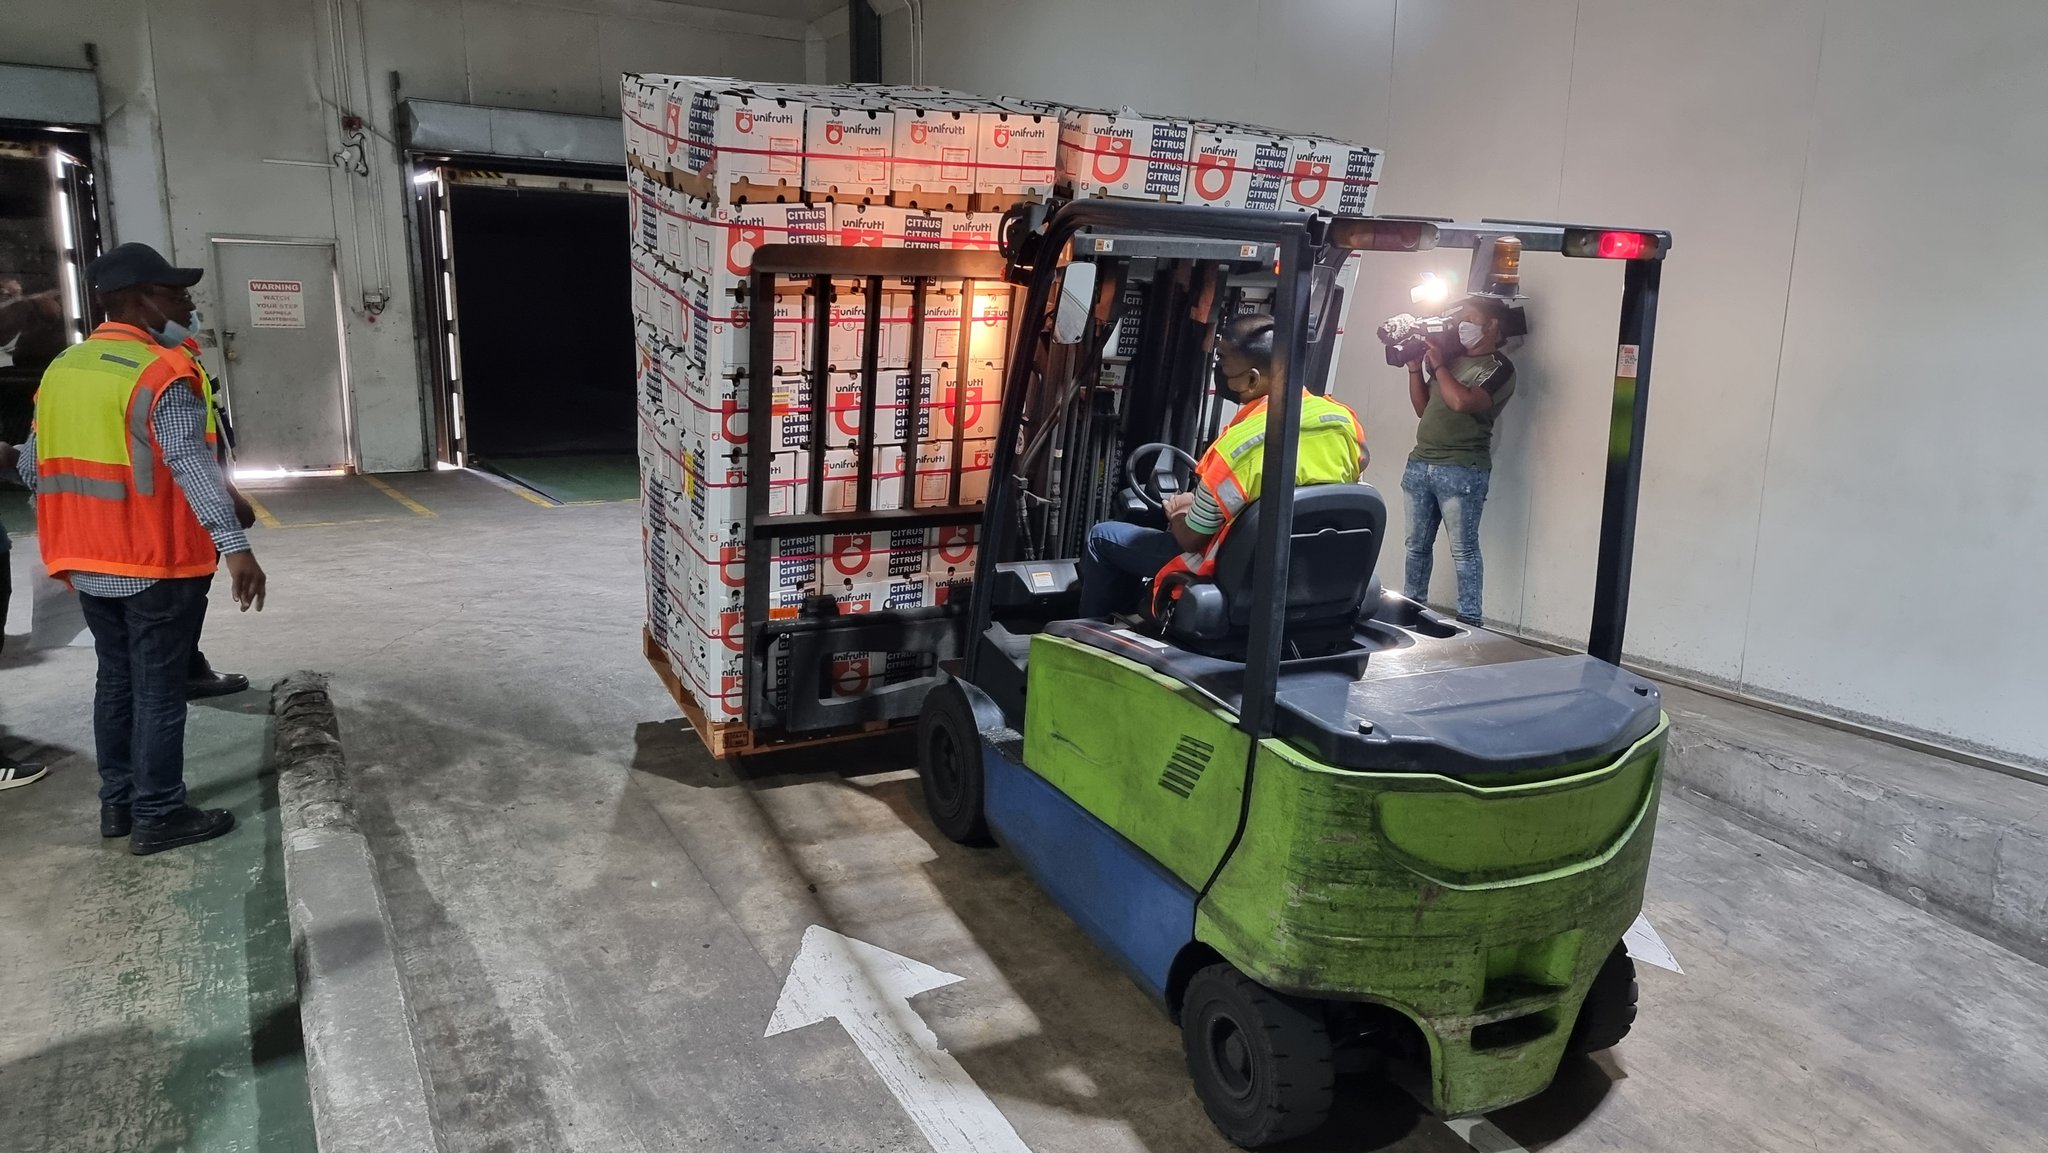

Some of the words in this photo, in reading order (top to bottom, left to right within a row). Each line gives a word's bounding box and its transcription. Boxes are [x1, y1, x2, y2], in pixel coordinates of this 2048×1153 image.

[753, 111, 793, 124] unifrutti
[843, 122, 881, 136] unifrutti
[927, 123, 966, 136] unifrutti
[1009, 126, 1045, 139] unifrutti
[1093, 125, 1134, 138] unifrutti
[1153, 127, 1188, 139] CITRUS
[1152, 138, 1186, 150] CITRUS
[1150, 150, 1184, 161] CITRUS
[1200, 144, 1238, 158] unifrutti
[1256, 147, 1287, 159] CITRUS
[688, 157, 706, 168] CITR
[1296, 151, 1332, 164] unifrutti
[1149, 160, 1182, 172] CITRUS
[1147, 171, 1180, 183] CITRUS
[1145, 182, 1179, 193] CITRUS
[1247, 189, 1278, 200] CITRUS
[1245, 200, 1276, 211] CITRUS
[787, 210, 825, 221] CITRUS
[842, 217, 885, 230] unifrutti
[906, 218, 942, 229] CITRUS
[953, 221, 992, 232] unifrutti
[788, 233, 826, 245] CITRUS
[251, 282, 299, 291] WARNING
[783, 413, 811, 423] CITRU
[783, 424, 811, 434] CITRU
[783, 434, 811, 444] CITRU
[891, 527, 924, 538] CITRUS
[780, 535, 815, 547] CITRUS
[891, 537, 923, 548] CITRUS
[780, 545, 815, 557] CITRUS
[890, 555, 922, 566] CITRUS
[780, 563, 815, 575] CITRUS
[889, 564, 921, 575] CITRUS
[780, 573, 815, 586] CITRUS
[890, 582, 923, 594] CITRUS
[895, 601, 922, 610] ITRUS
